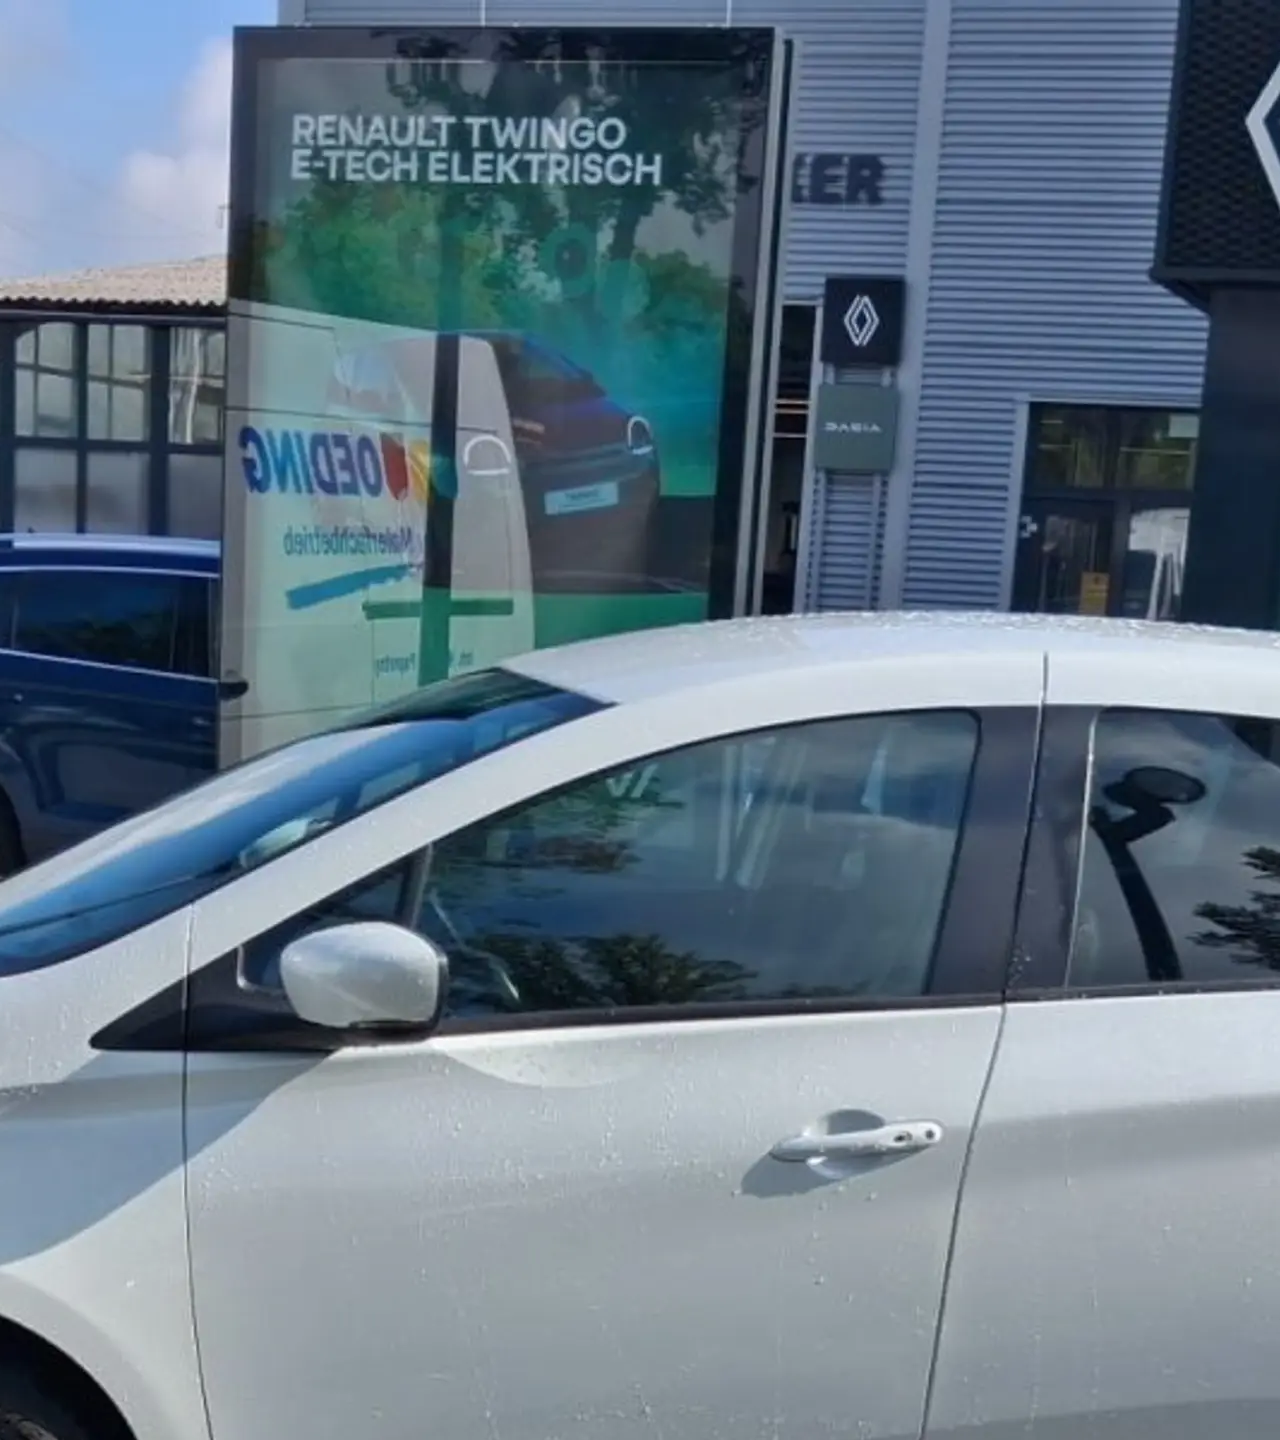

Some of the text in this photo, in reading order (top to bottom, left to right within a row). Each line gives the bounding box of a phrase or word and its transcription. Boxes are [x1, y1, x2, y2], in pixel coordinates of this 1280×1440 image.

[292, 114, 627, 150] RENAULT TWINGO
[290, 148, 663, 186] E-TECH ELEKTRISCH
